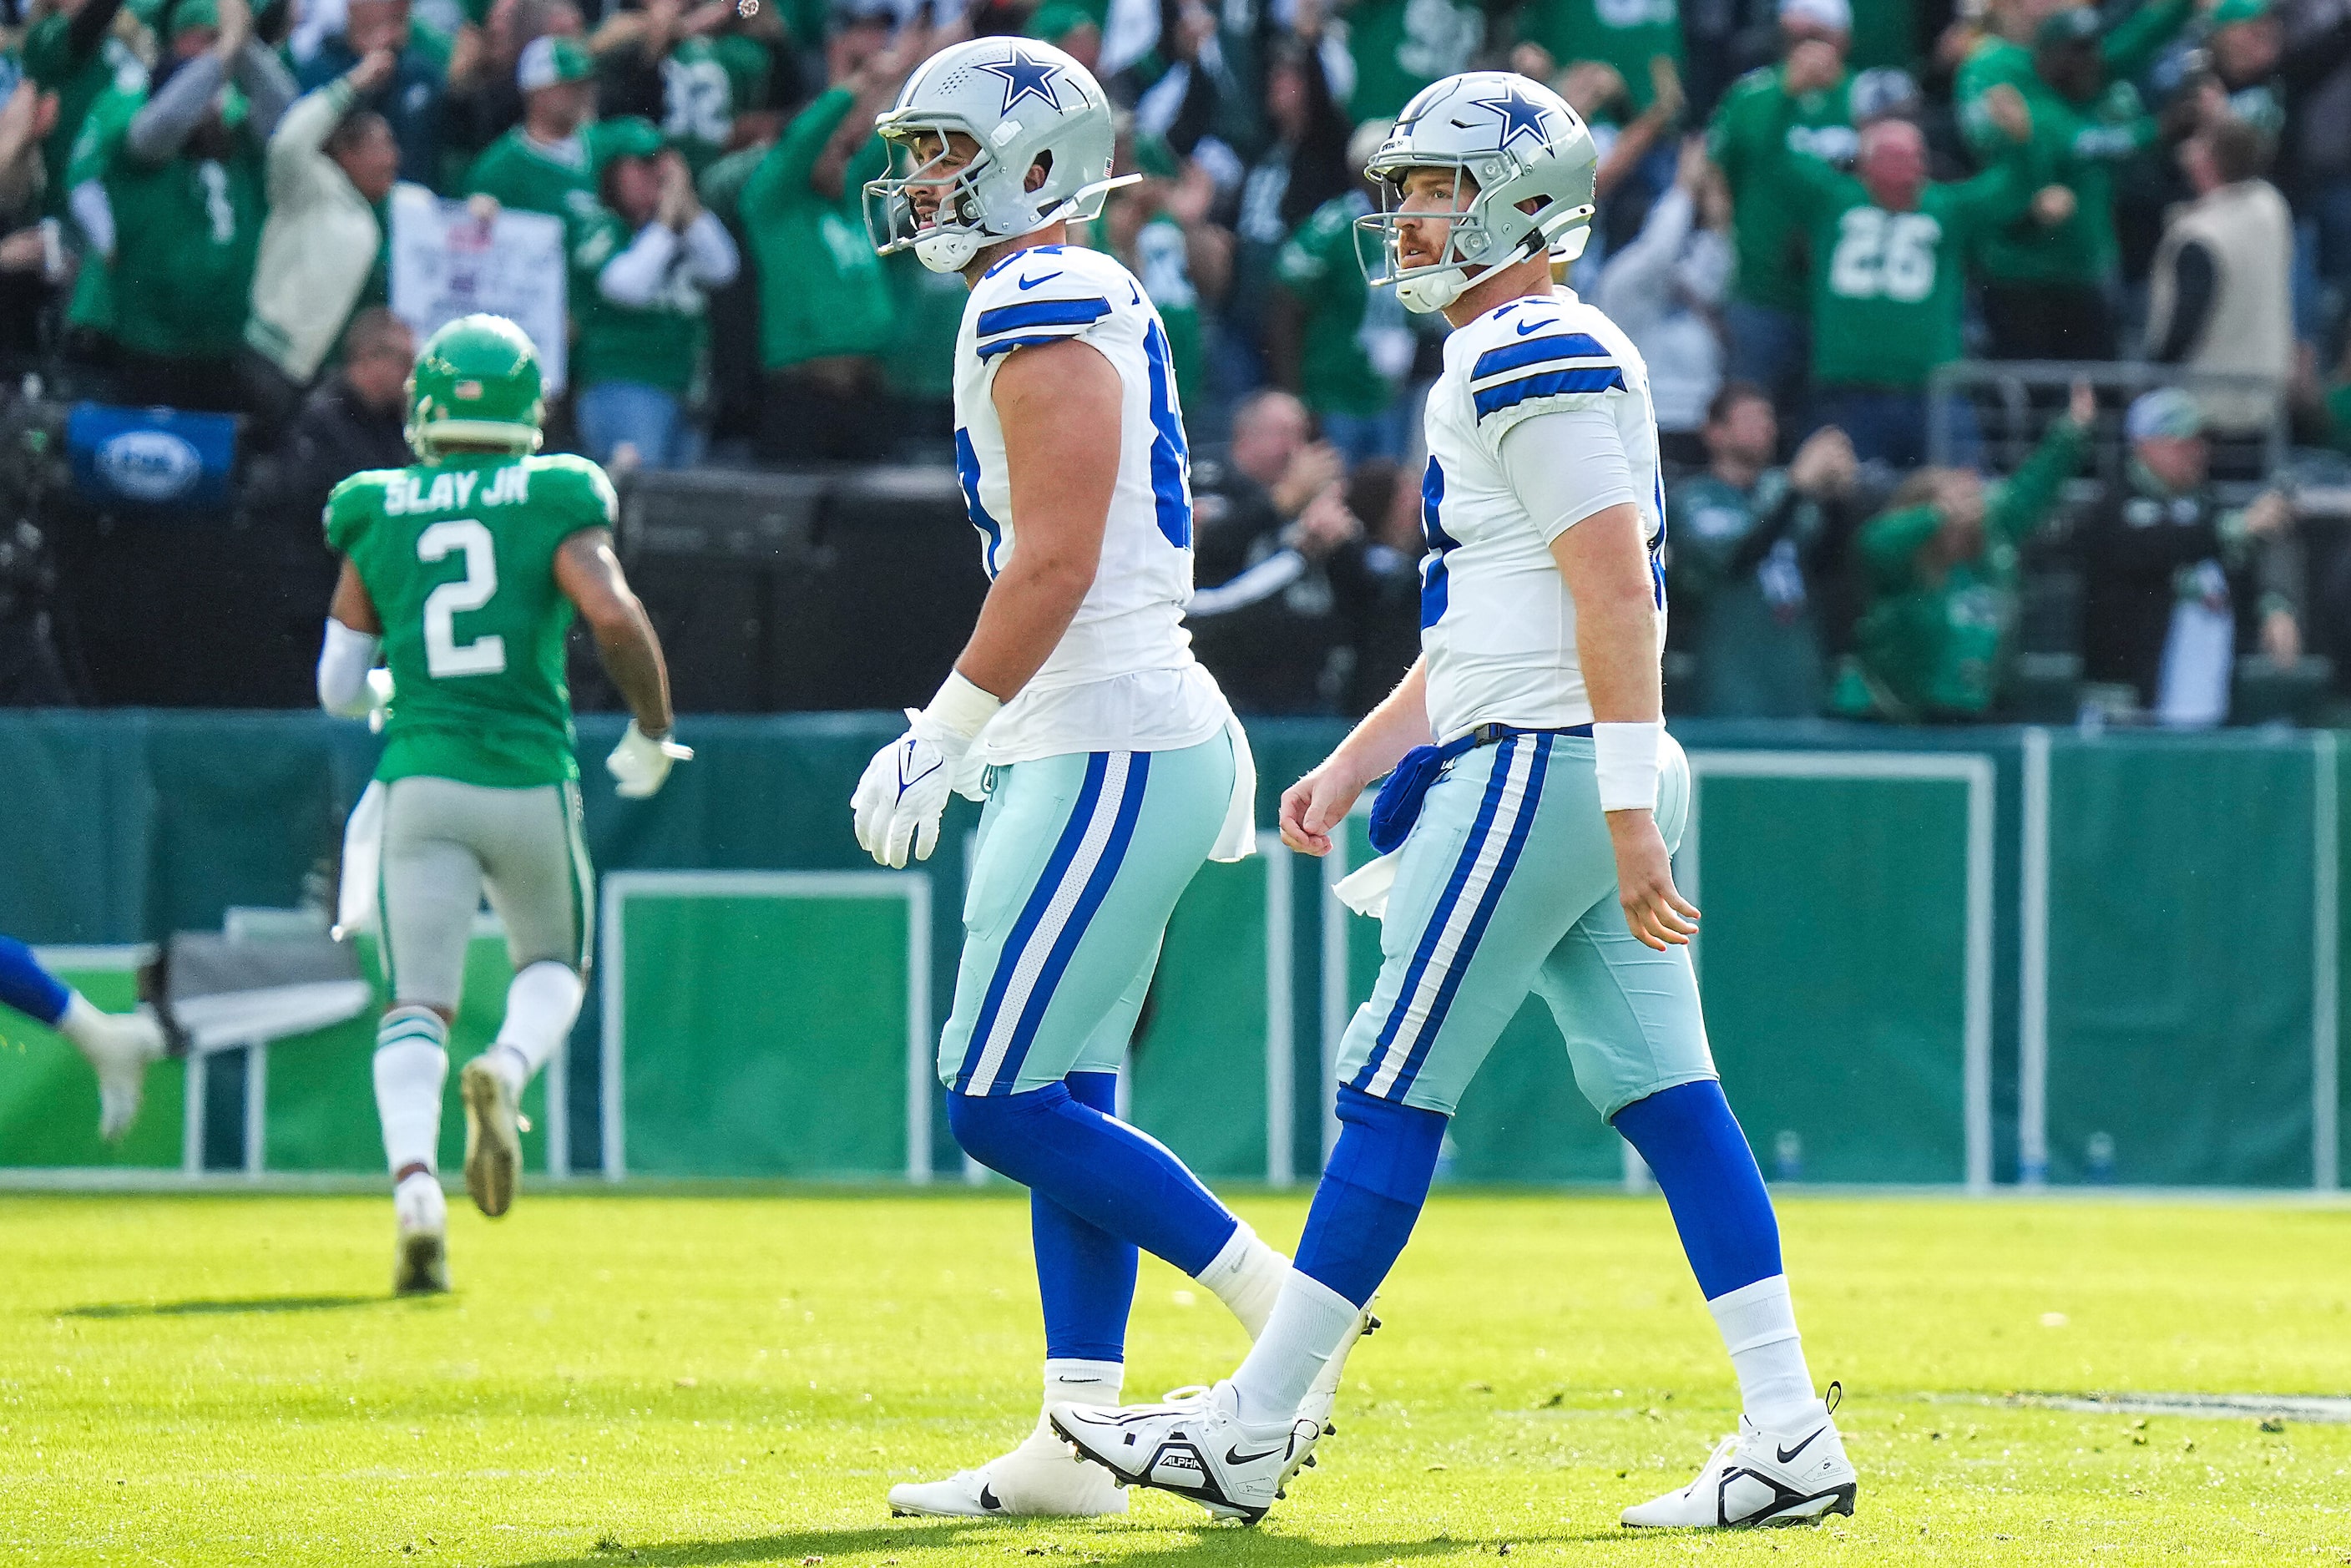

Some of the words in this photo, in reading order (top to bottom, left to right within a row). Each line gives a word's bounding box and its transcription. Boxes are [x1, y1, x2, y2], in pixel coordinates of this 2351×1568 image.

[1828, 205, 1942, 302] 26
[384, 469, 478, 516] SLAY
[481, 465, 530, 506] JR
[418, 518, 506, 678] 2
[1162, 1455, 1203, 1469] ALPHA
